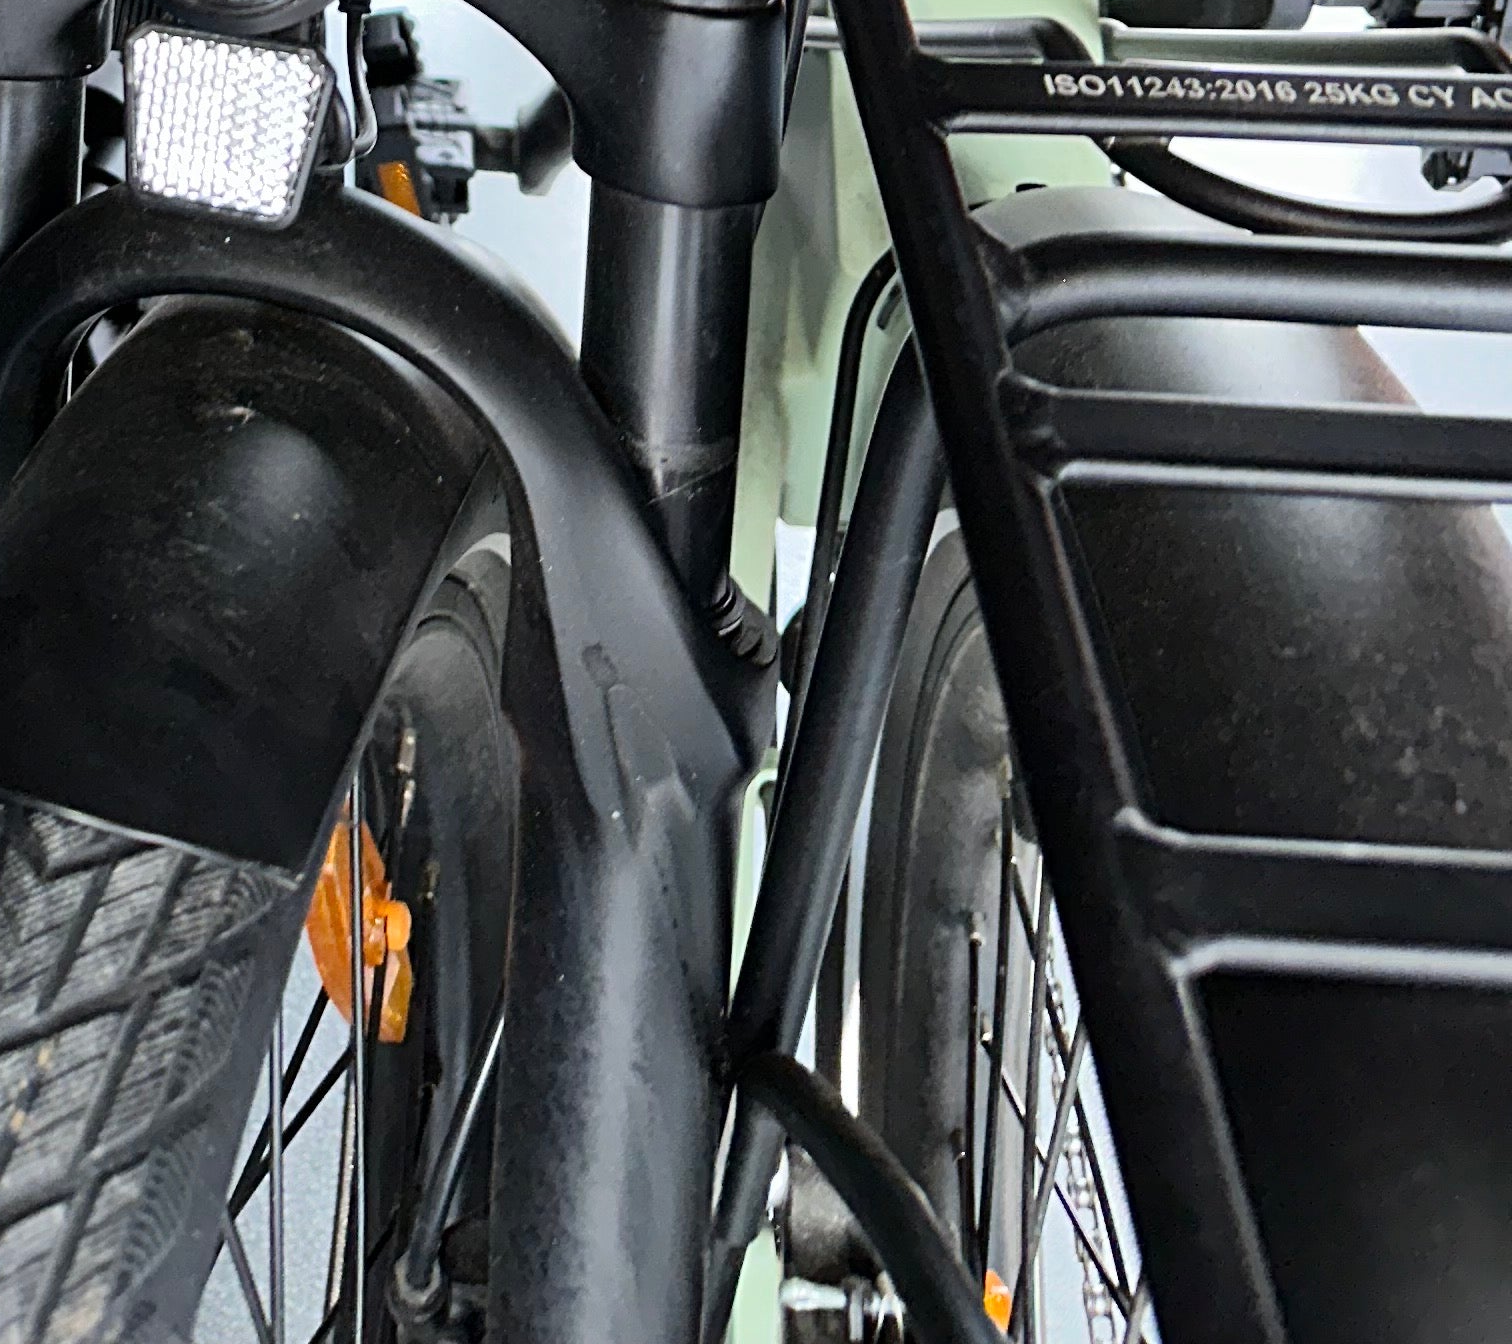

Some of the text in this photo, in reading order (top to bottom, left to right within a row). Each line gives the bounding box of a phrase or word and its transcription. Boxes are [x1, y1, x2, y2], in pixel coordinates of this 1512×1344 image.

[1042, 73, 1297, 103] ISO11243:2016
[1306, 80, 1400, 107] 25KG
[1408, 84, 1455, 109] CY
